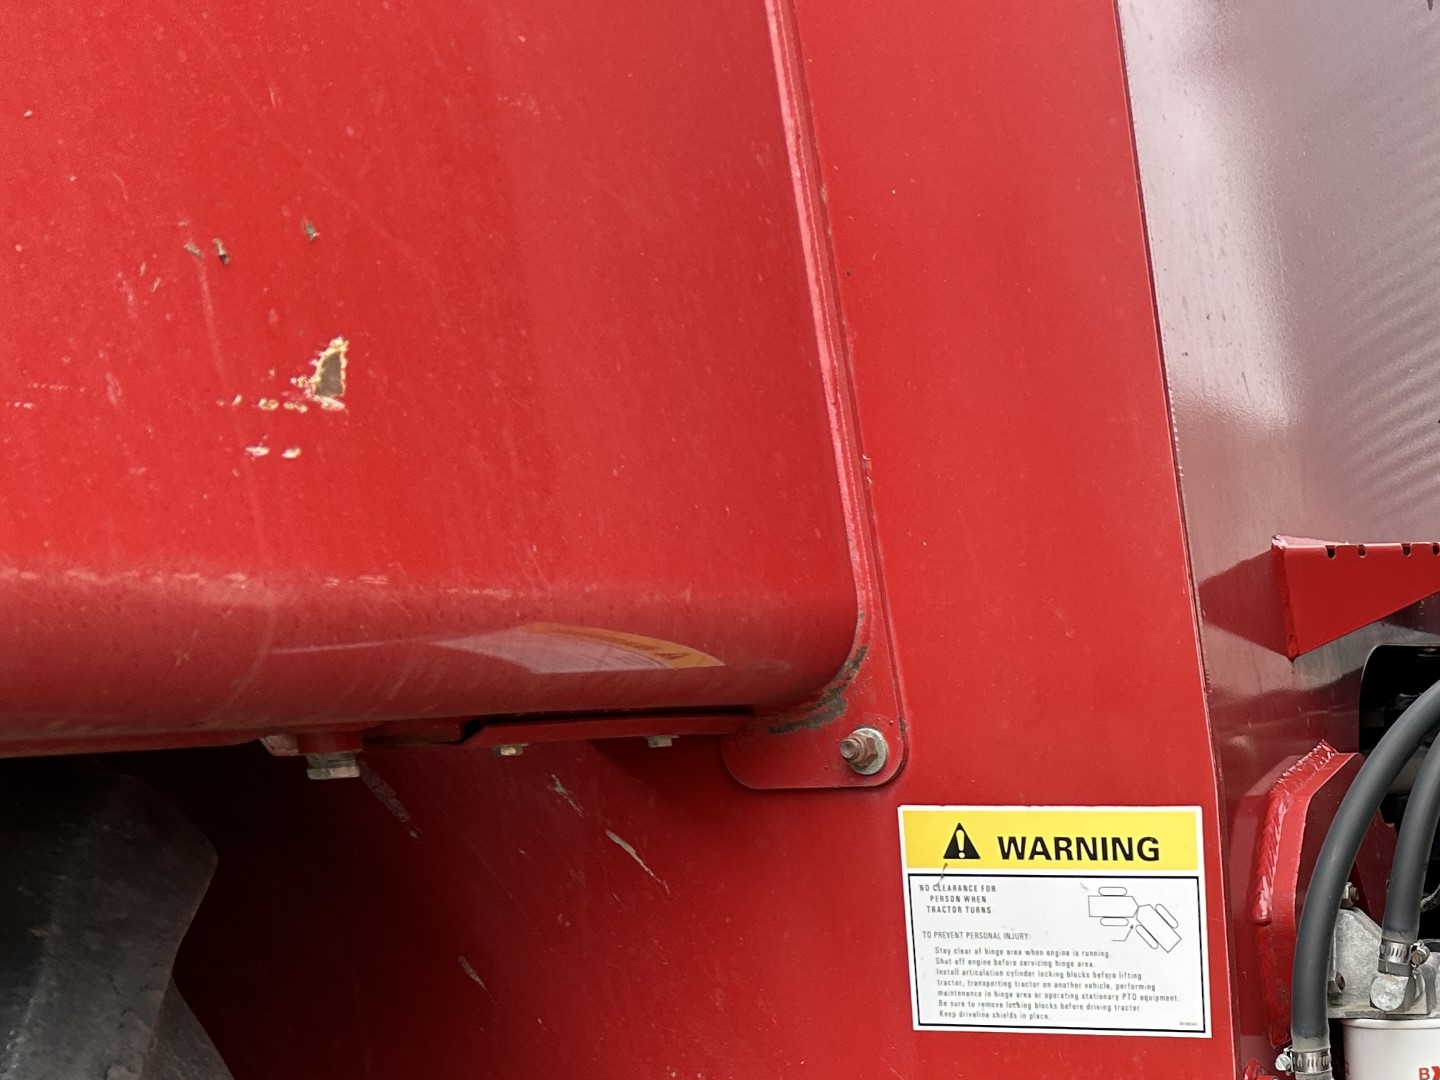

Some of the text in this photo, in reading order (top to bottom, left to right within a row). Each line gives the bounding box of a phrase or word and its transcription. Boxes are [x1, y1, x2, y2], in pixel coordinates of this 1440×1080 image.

[997, 835, 1161, 861] WARNING
[919, 884, 996, 892] NO CLEARANCE FOR
[929, 895, 986, 903] PERSON WHEN
[926, 905, 992, 914] TRACTOR TURNS
[922, 930, 932, 939] TO
[933, 931, 963, 939] PREVENT
[965, 931, 1001, 940] PERSONAL
[934, 946, 951, 956] Stay
[953, 947, 971, 955] clear
[974, 947, 982, 955] of
[984, 948, 1004, 957] hinge
[1024, 948, 1044, 956] when
[1046, 950, 1070, 958] engine
[935, 957, 952, 965] Shut
[954, 957, 965, 965] off
[967, 959, 991, 967] engine
[993, 958, 1017, 966] before
[1019, 960, 1052, 968] servicing
[1054, 960, 1074, 969] hinge
[936, 968, 1142, 981] Install articulation cylinder locking blocks before lifting
[967, 980, 1012, 989] transporting
[1054, 981, 1082, 989] another
[1115, 982, 1156, 992] performing
[993, 990, 1013, 1000] hinge
[1044, 992, 1079, 1001] operating
[1081, 993, 1119, 1001] stationary
[1122, 992, 1137, 1001] PTO
[1139, 994, 1178, 1003] equipment.
[938, 999, 948, 1007] Be
[1005, 1001, 1032, 1010] locking
[1060, 1002, 1084, 1010] before
[1086, 1003, 1112, 1012] driving
[939, 1010, 957, 1020] Keep
[958, 1010, 990, 1018] driveline
[992, 1011, 1017, 1019] shields
[1418, 1068, 1430, 1080] B
